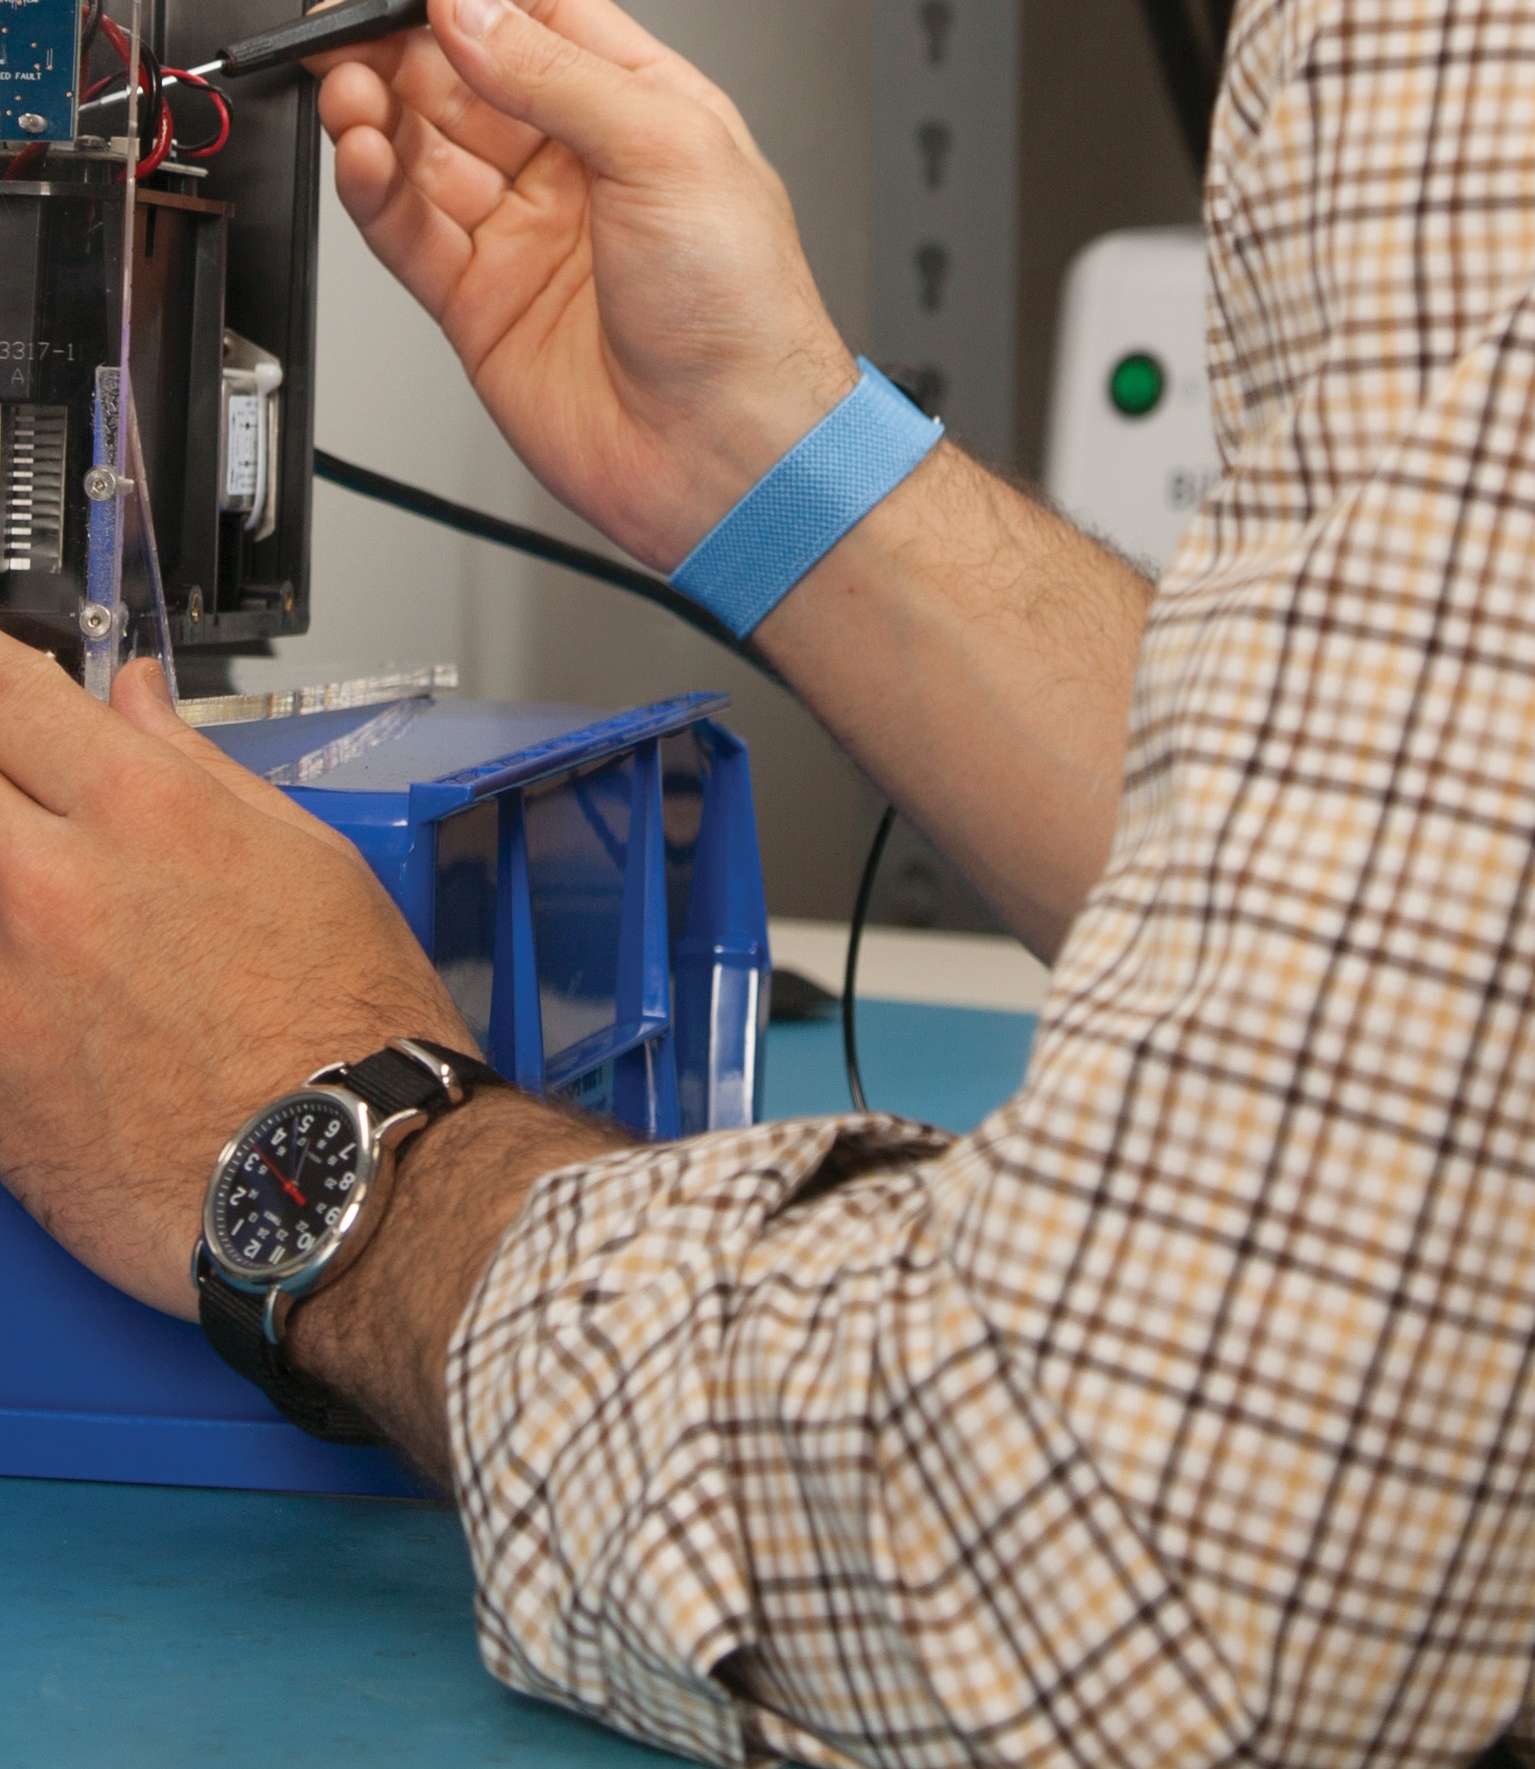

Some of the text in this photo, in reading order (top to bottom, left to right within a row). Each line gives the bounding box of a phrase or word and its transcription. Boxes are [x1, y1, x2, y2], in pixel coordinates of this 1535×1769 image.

[15, 72, 42, 80] FAULT
[11, 367, 25, 385] A
[298, 1115, 314, 1133] 5
[325, 1119, 341, 1138] 6
[270, 1128, 287, 1146] 4
[339, 1142, 356, 1161] 7
[244, 1153, 260, 1171] 3
[339, 1171, 356, 1191] 8
[230, 1186, 247, 1206] 2
[324, 1207, 341, 1226] 9
[230, 1218, 244, 1236] 1
[243, 1239, 262, 1260] 12
[297, 1232, 316, 1251] 10
[268, 1245, 286, 1265] 11
